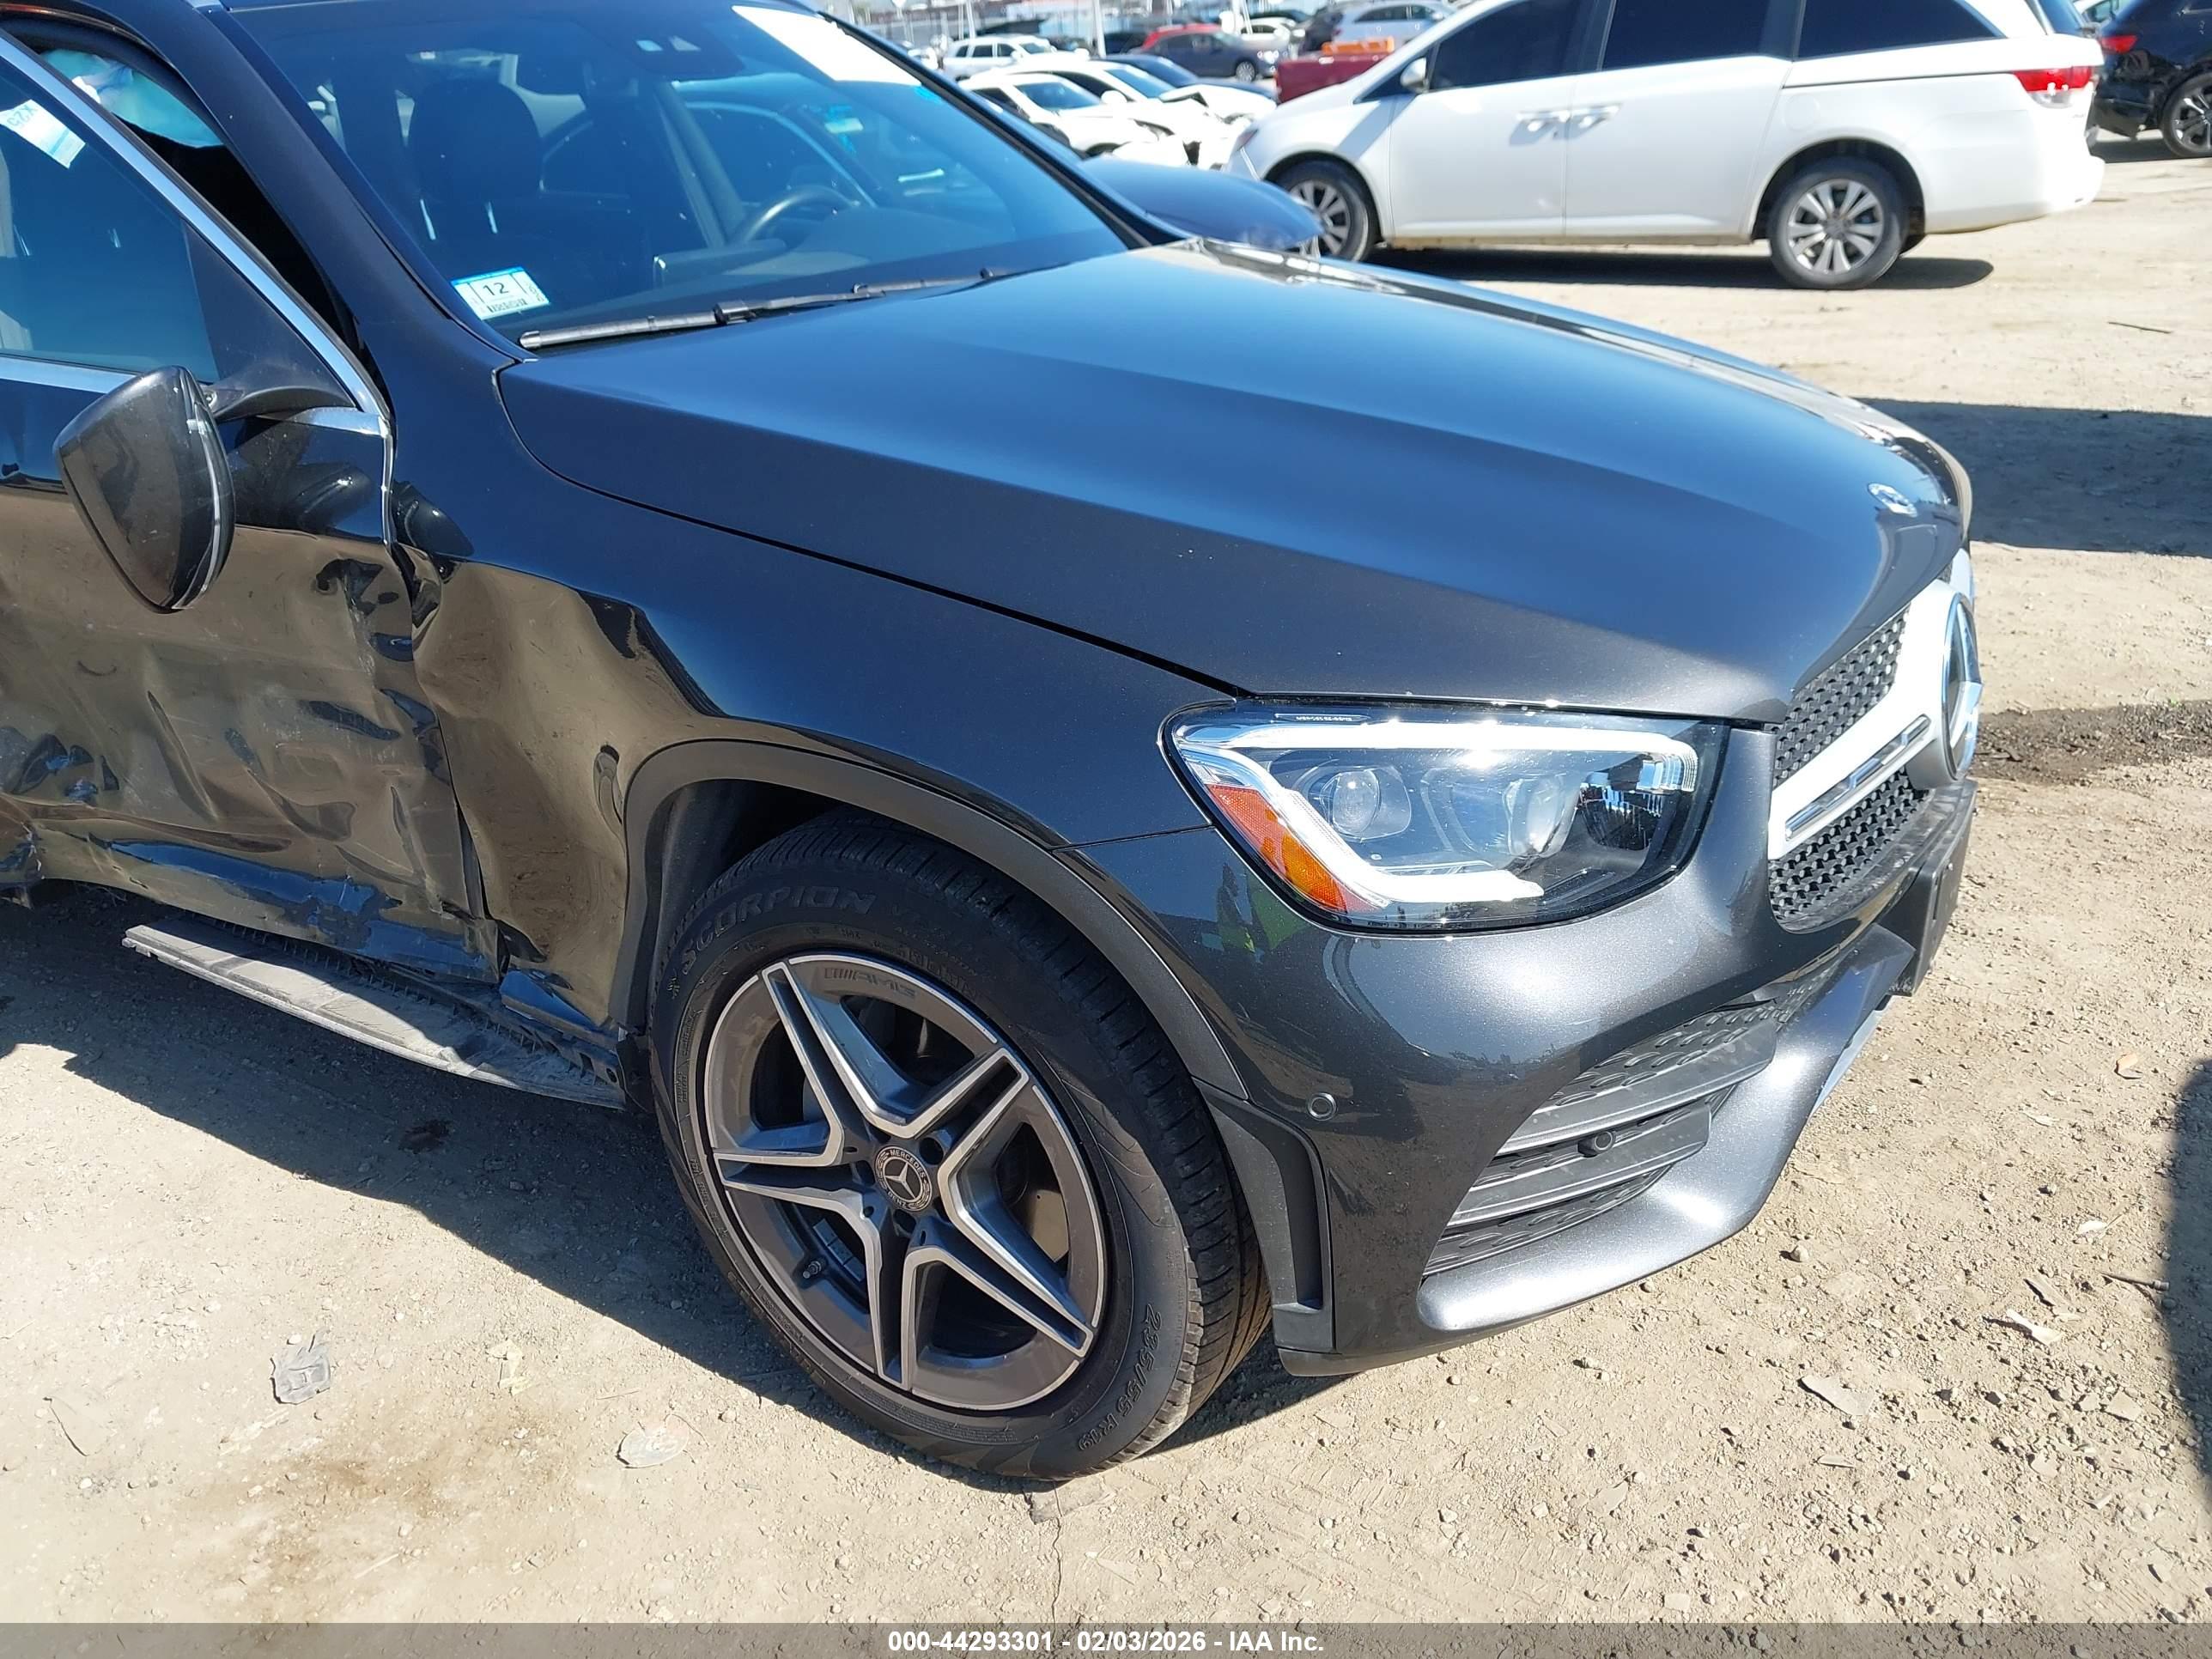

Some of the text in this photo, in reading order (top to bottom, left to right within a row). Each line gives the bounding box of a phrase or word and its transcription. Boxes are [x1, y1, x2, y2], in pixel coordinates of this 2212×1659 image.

[483, 282, 509, 296] 12
[682, 885, 877, 975] SCORPION
[854, 970, 916, 999] AMG
[890, 1149, 927, 1178] MERCEDES
[888, 1191, 907, 1208] BENZ
